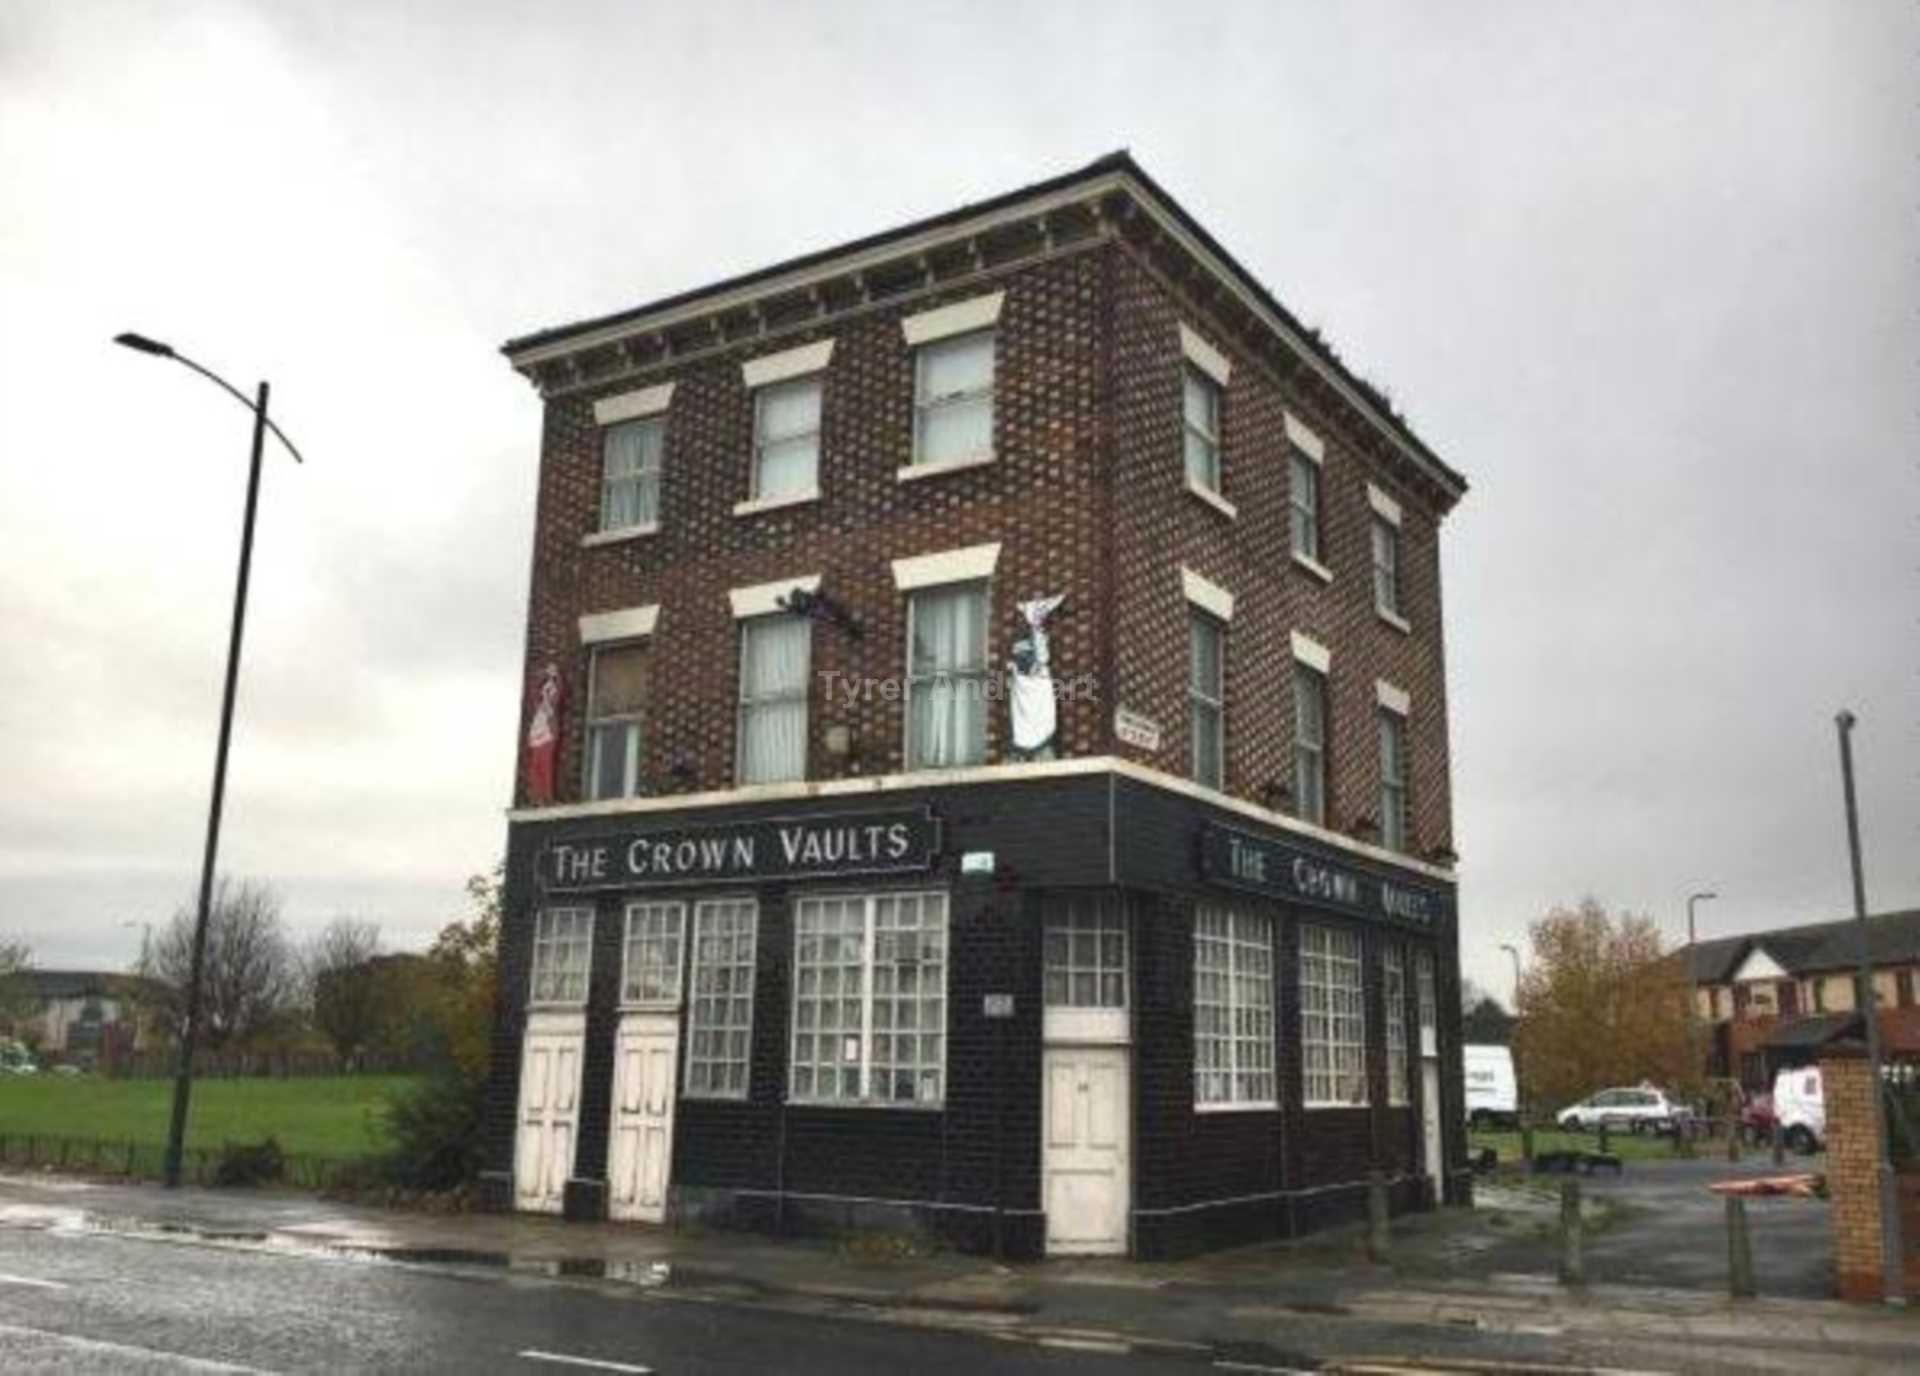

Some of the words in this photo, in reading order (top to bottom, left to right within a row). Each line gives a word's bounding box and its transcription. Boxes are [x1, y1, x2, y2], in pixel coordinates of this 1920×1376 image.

[551, 844, 606, 882] THE
[628, 836, 756, 875] CROWN
[781, 822, 910, 865] VAULTS
